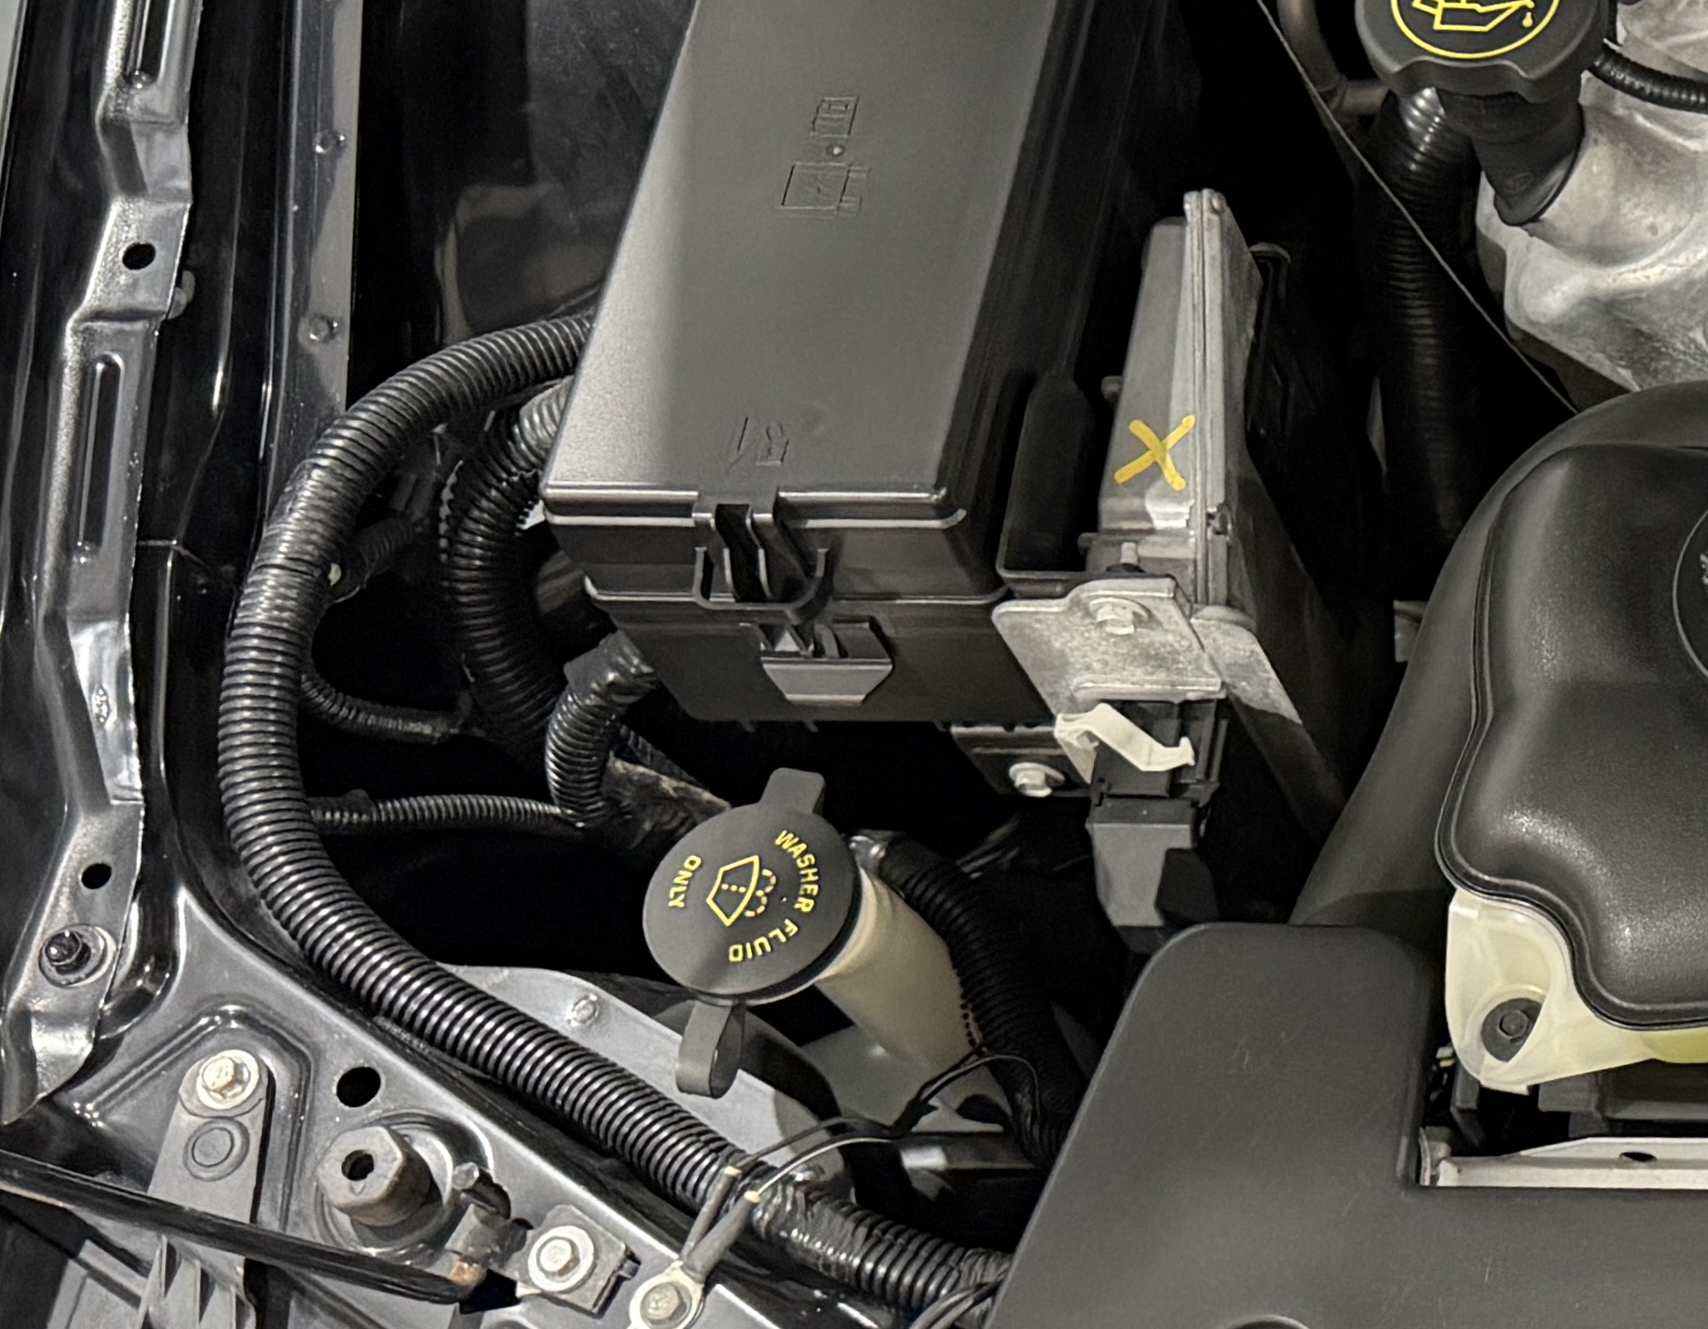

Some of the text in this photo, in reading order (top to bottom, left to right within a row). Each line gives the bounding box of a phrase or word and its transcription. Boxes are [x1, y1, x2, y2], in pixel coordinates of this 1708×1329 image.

[668, 855, 702, 908] ONLY
[774, 830, 819, 913] WASHER
[728, 918, 799, 963] FLUID
